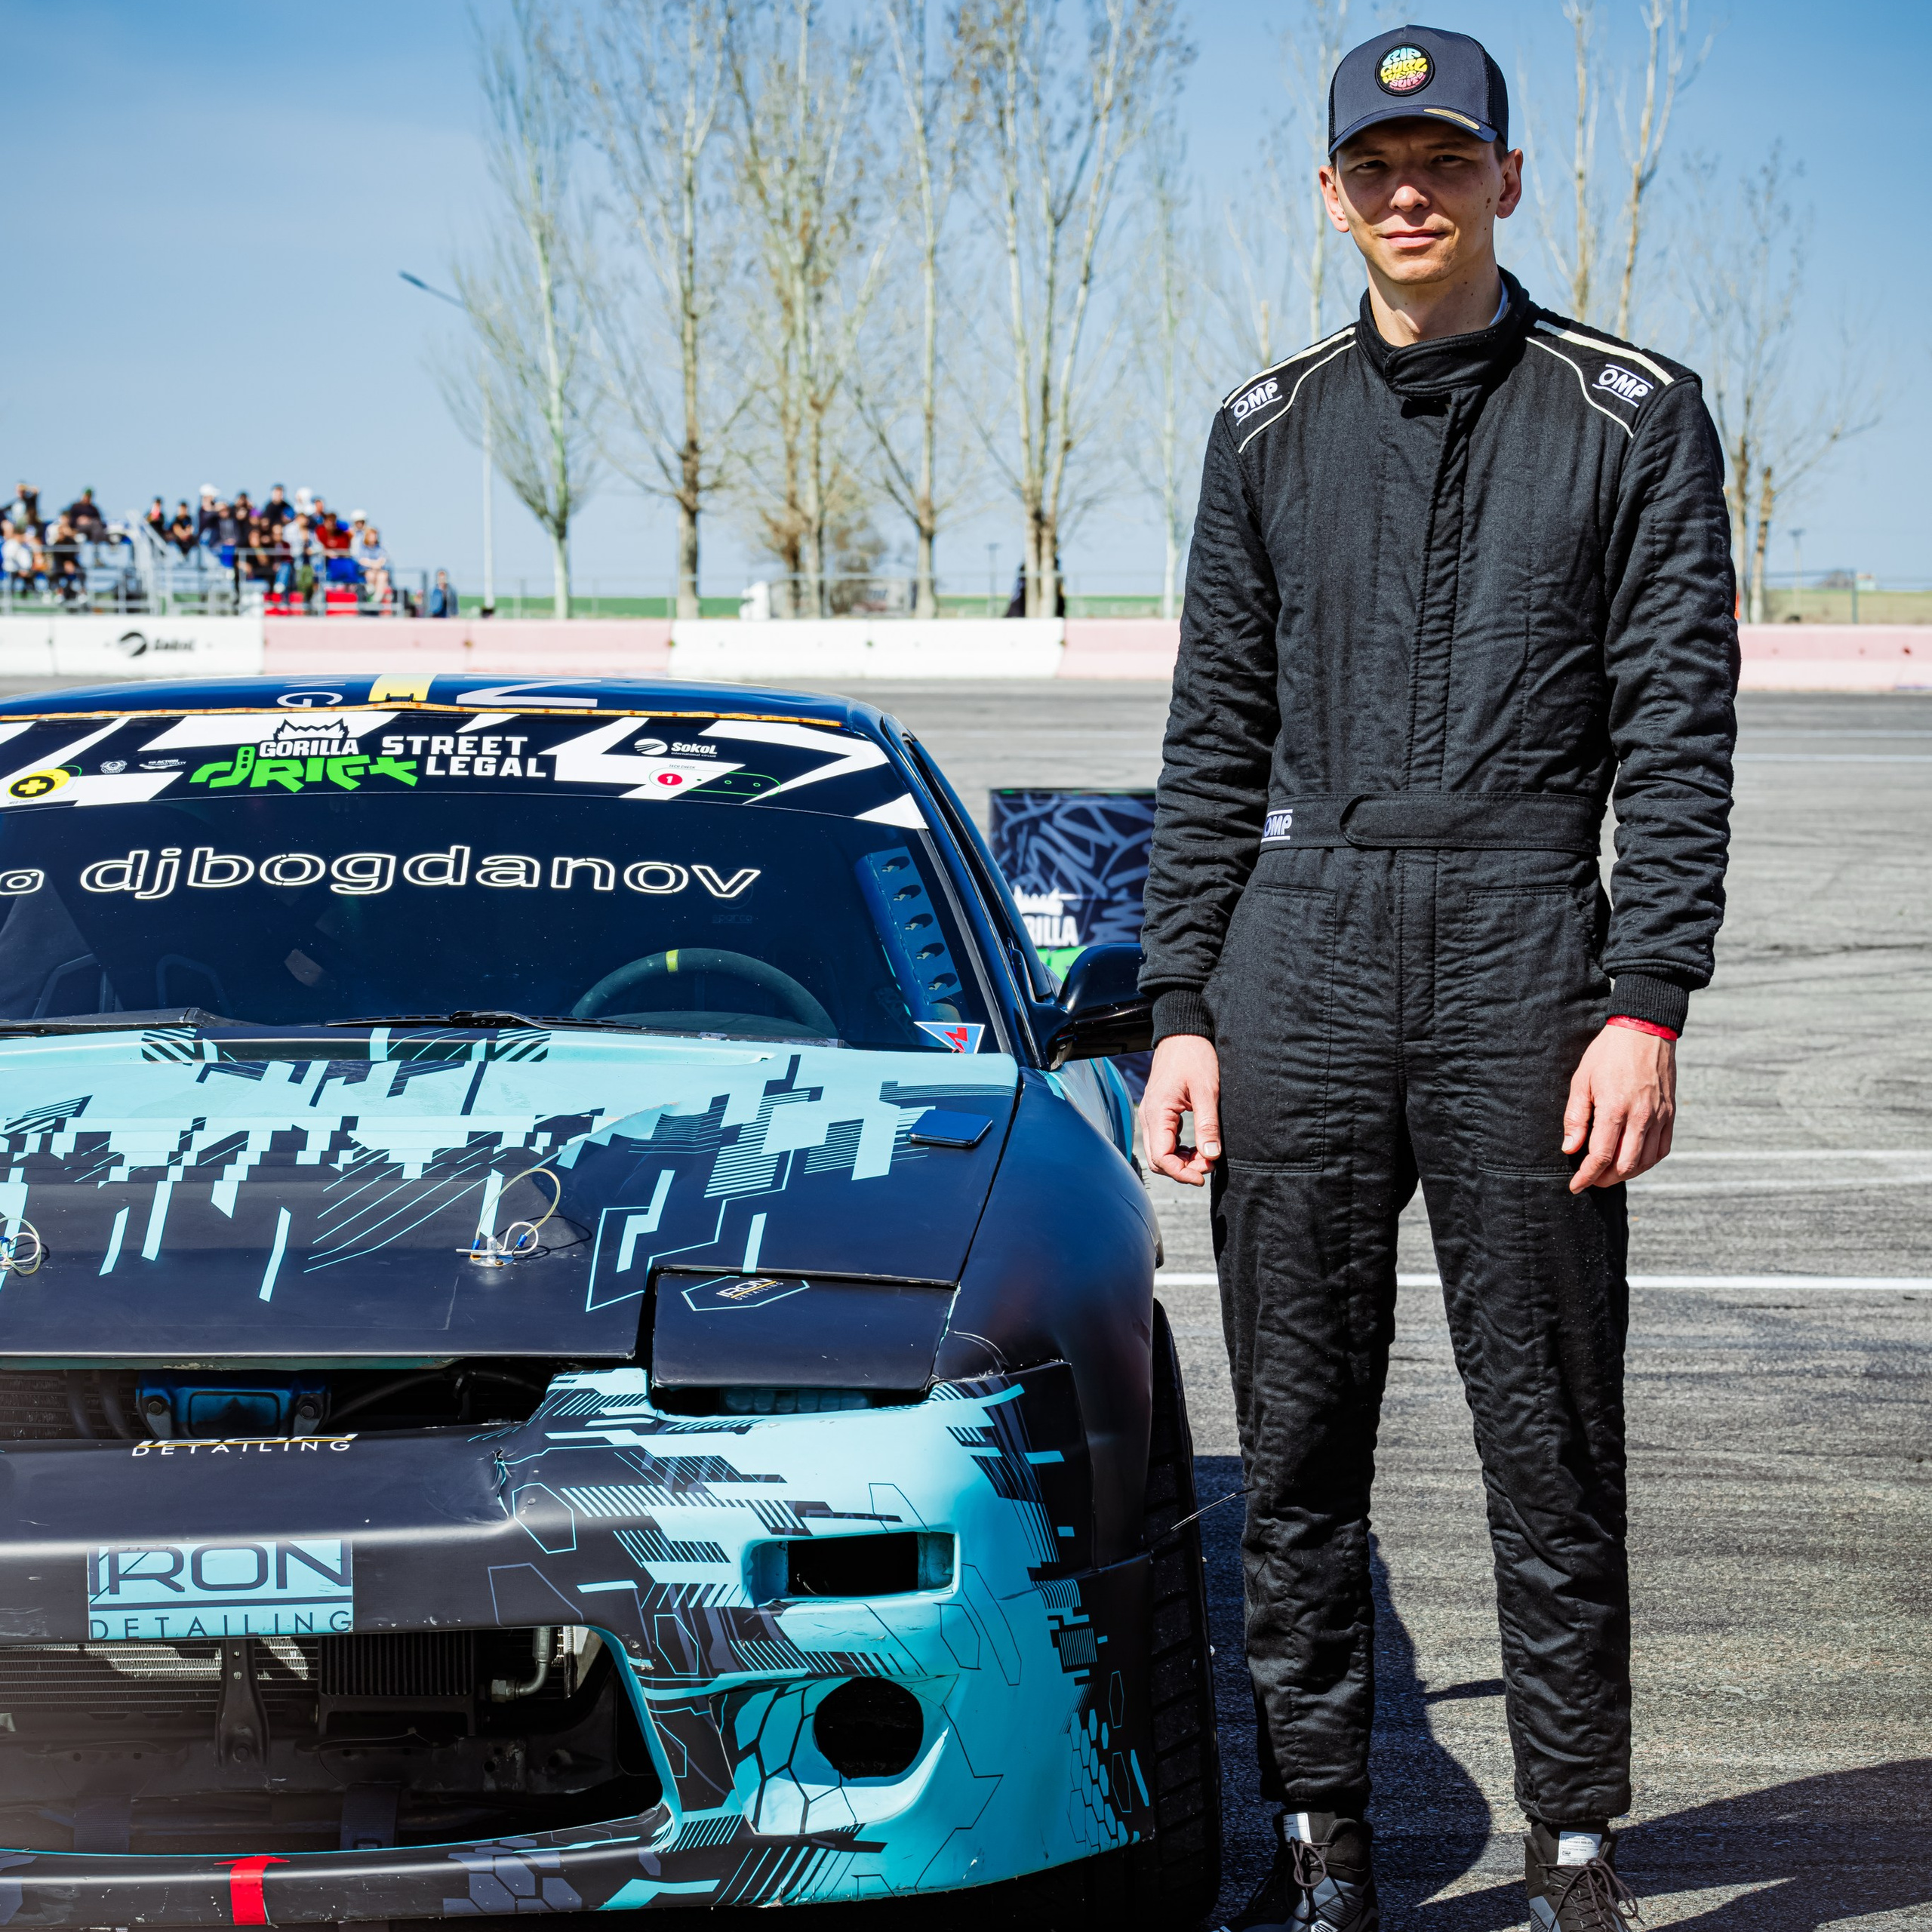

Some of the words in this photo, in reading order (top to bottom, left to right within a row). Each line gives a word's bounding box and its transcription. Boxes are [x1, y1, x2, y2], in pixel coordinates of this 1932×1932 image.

[1380, 57, 1428, 78] CURL
[1383, 48, 1422, 66] RIP
[1598, 368, 1649, 398] OMP
[1233, 381, 1278, 418] OMP
[259, 739, 359, 756] GORILLA
[381, 735, 528, 755] STREET
[425, 756, 546, 777] LEGAL
[1264, 814, 1292, 837] OMP
[80, 844, 761, 900] djbogdanov
[1024, 915, 1079, 946] RILLA
[716, 1278, 774, 1297] IRON
[734, 1281, 784, 1301] DETAILING
[131, 1440, 351, 1457] DETAILING
[89, 1540, 352, 1595] IRON
[89, 1610, 353, 1640] DETAILING
